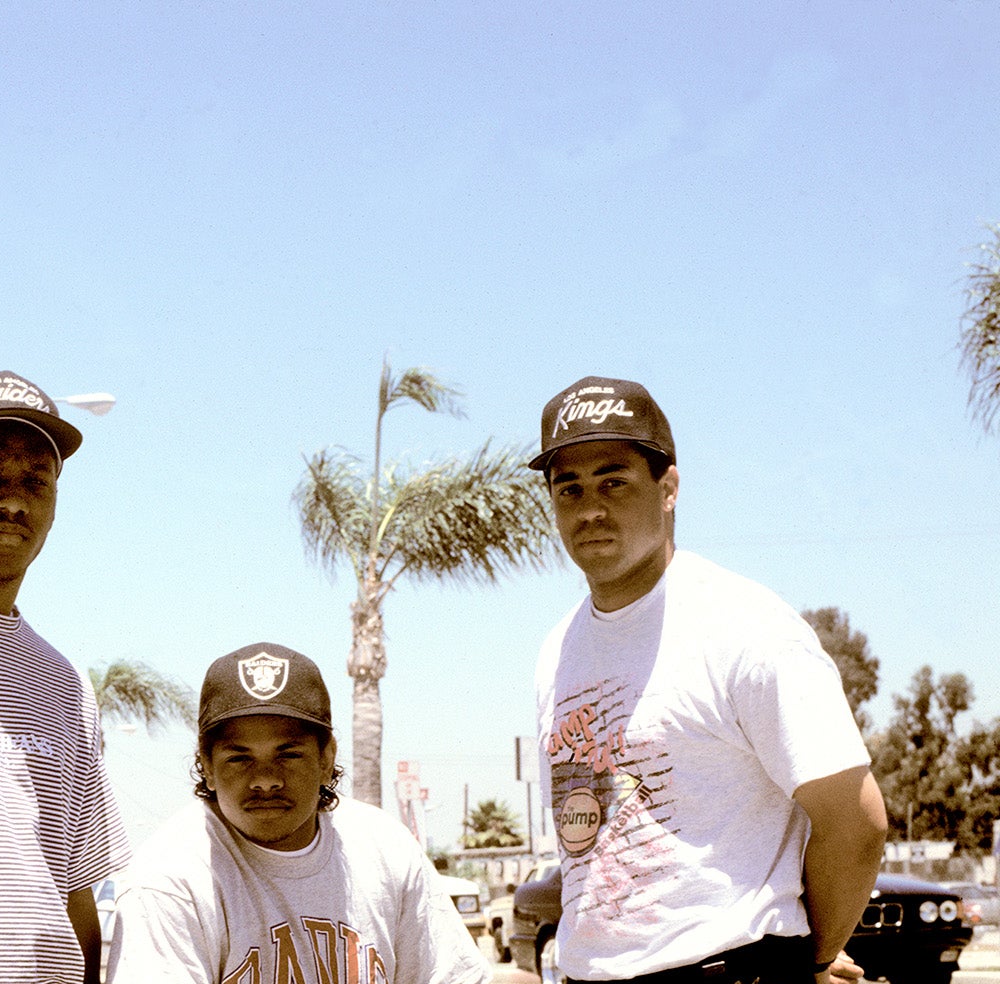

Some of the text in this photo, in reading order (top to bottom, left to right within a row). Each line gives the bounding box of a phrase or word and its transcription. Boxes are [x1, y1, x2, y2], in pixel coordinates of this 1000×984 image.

[563, 386, 615, 403] LOS ANGELES
[551, 398, 634, 438] Kings
[561, 811, 598, 829] pump
